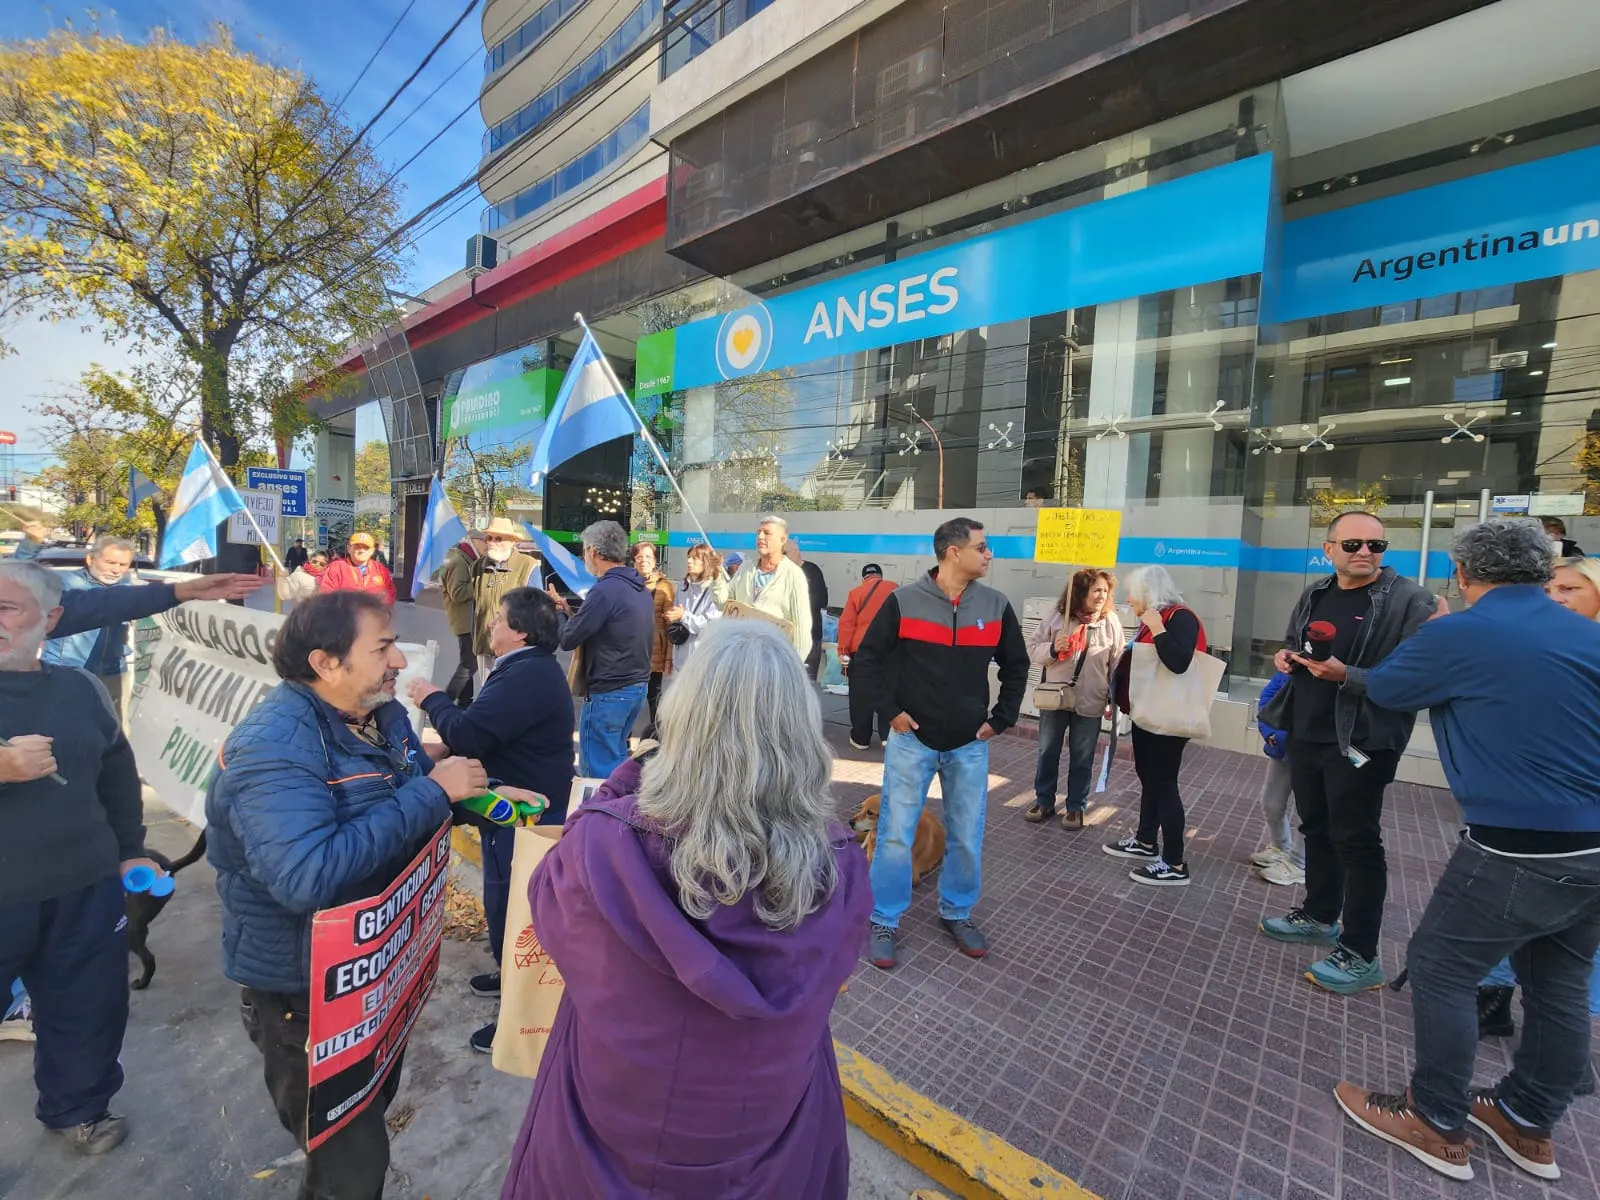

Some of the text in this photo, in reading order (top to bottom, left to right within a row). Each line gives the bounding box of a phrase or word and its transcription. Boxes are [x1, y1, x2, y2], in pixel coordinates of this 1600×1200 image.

[1352, 218, 1600, 283] Argentinaun
[803, 266, 959, 344] ANSES
[252, 471, 288, 480] EXCLUSIVO
[358, 854, 431, 941] GENTICIDIO
[335, 914, 412, 995] ECOCIDIO
[365, 984, 382, 1012] EL
